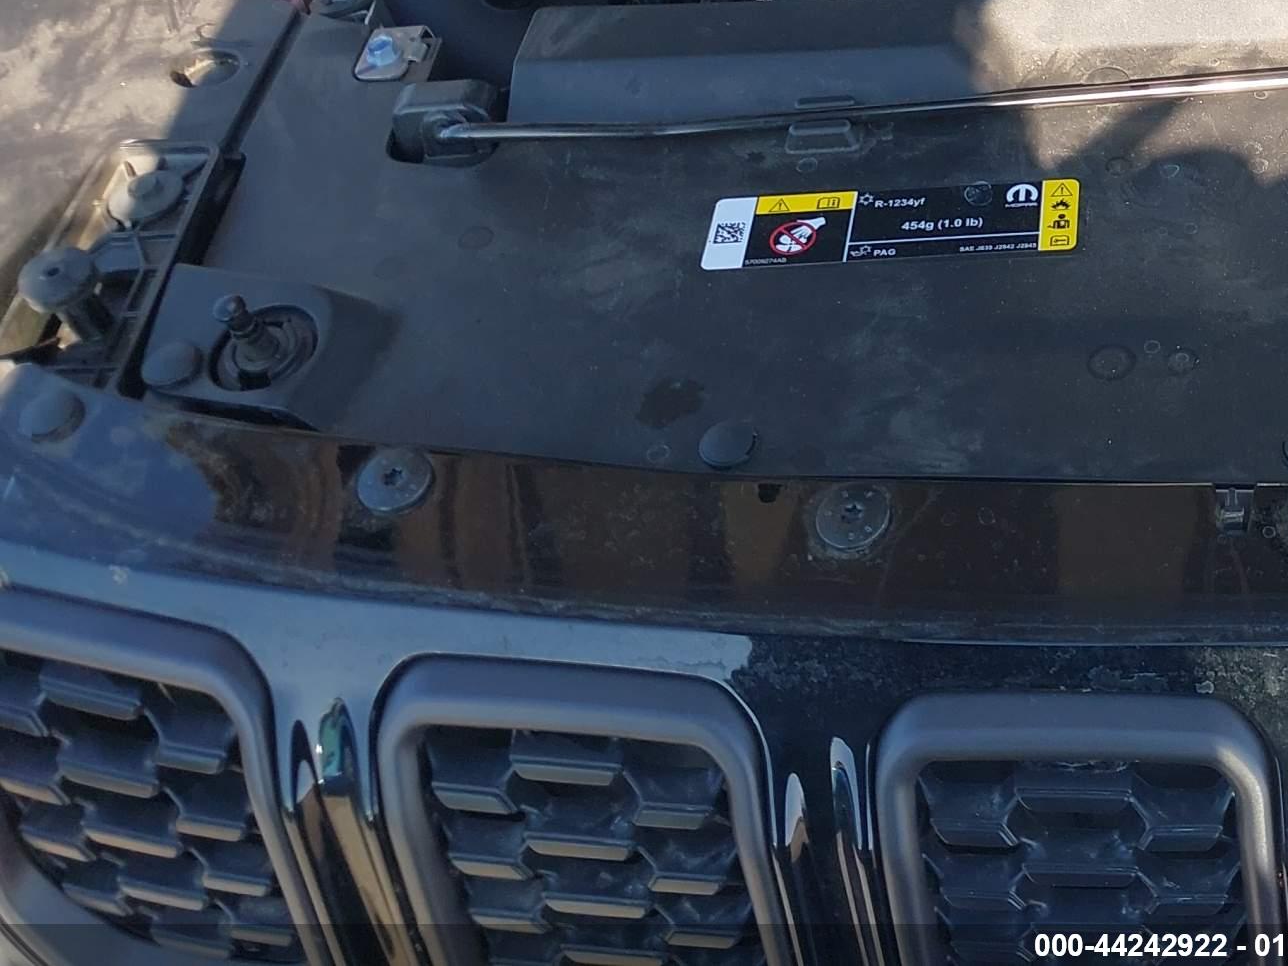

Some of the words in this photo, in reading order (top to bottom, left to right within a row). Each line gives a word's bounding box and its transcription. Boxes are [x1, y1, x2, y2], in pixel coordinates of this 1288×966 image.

[874, 197, 926, 208] R-1234yf
[901, 220, 935, 231] 454g
[937, 219, 963, 230] (1.0
[965, 217, 984, 228] lb)
[873, 248, 897, 257] PAG
